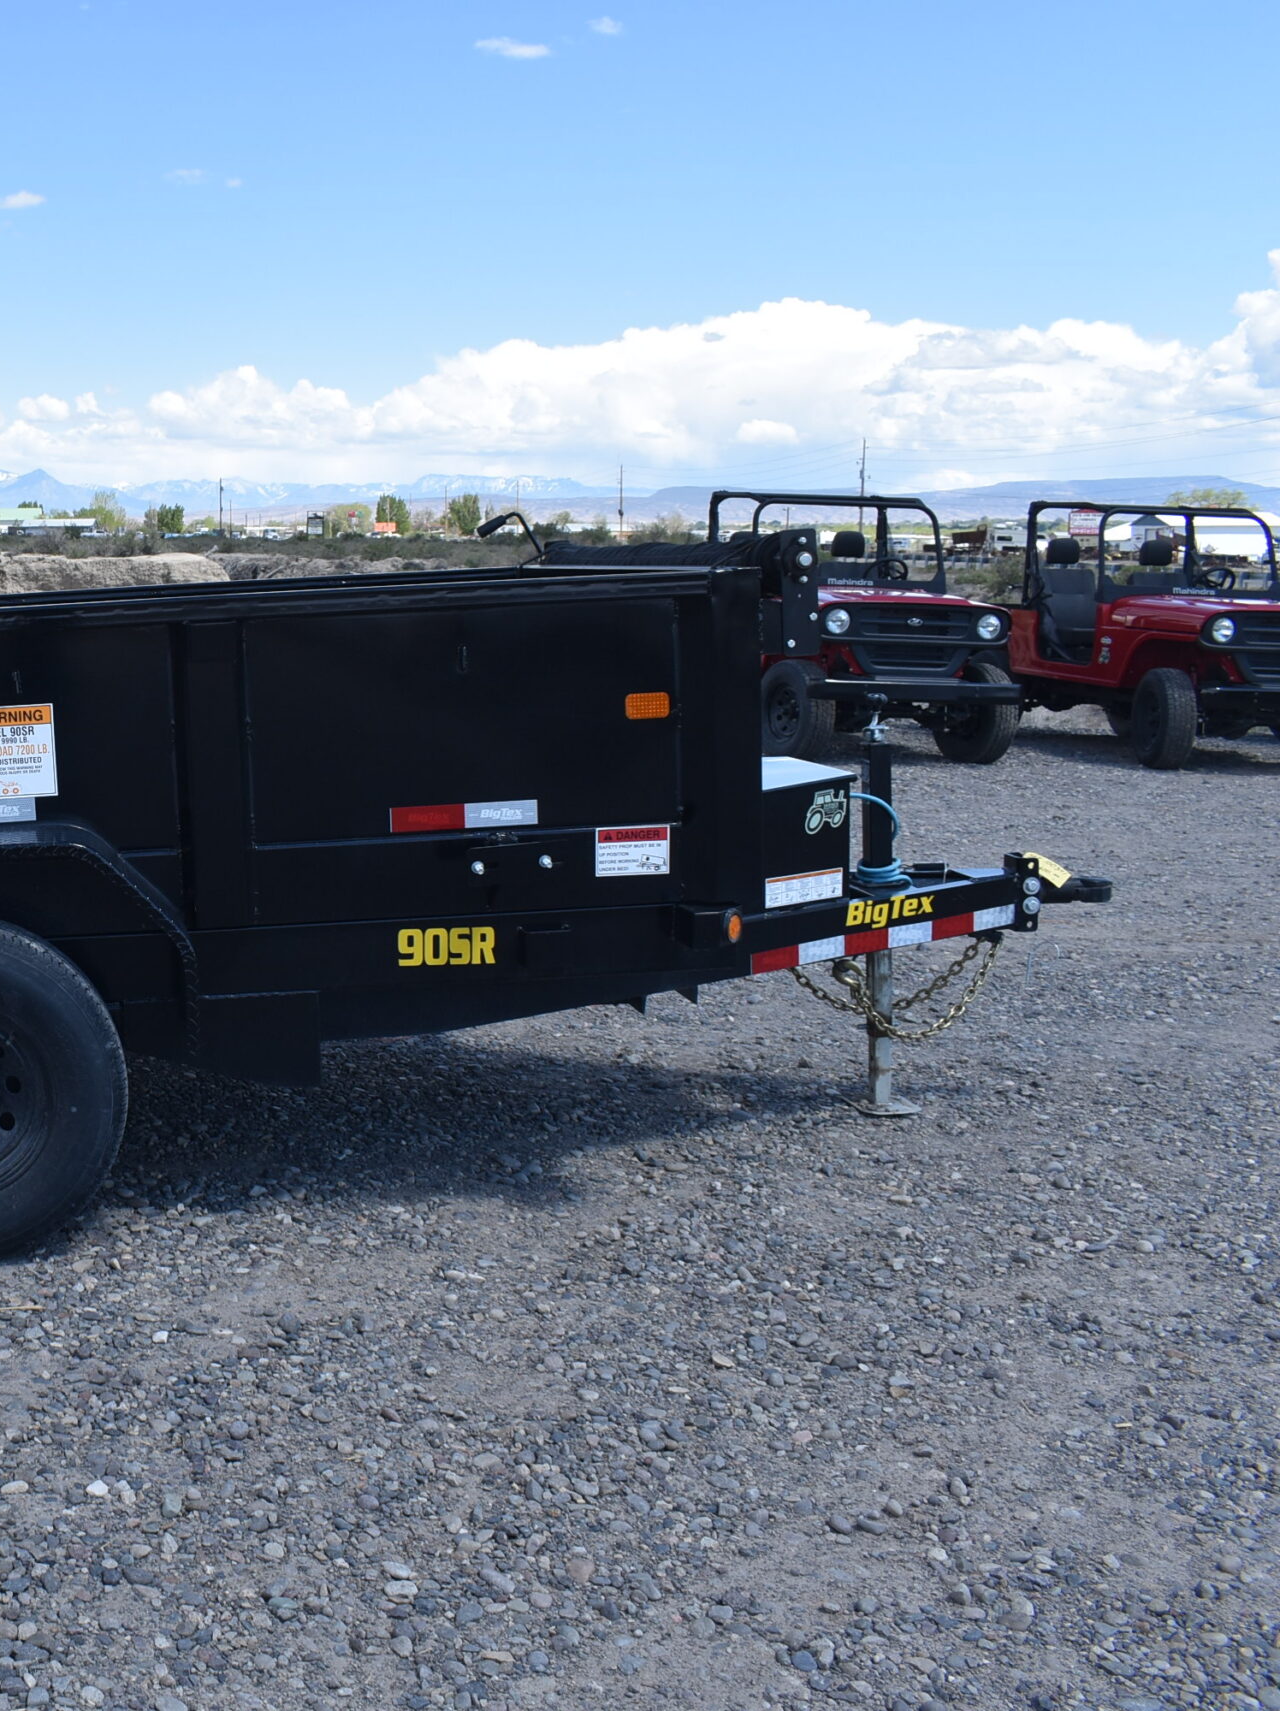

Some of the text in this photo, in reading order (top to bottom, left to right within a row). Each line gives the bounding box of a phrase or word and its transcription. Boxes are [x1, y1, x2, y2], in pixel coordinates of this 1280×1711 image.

[827, 577, 874, 586] Mahindra
[1172, 587, 1216, 596] Mahindra
[10, 726, 35, 737] 90SR
[16, 744, 36, 755] 7200
[480, 807, 523, 820] BigTex
[615, 830, 660, 840] DANGER
[845, 895, 935, 929] BigTex
[397, 926, 497, 967] 90SR
